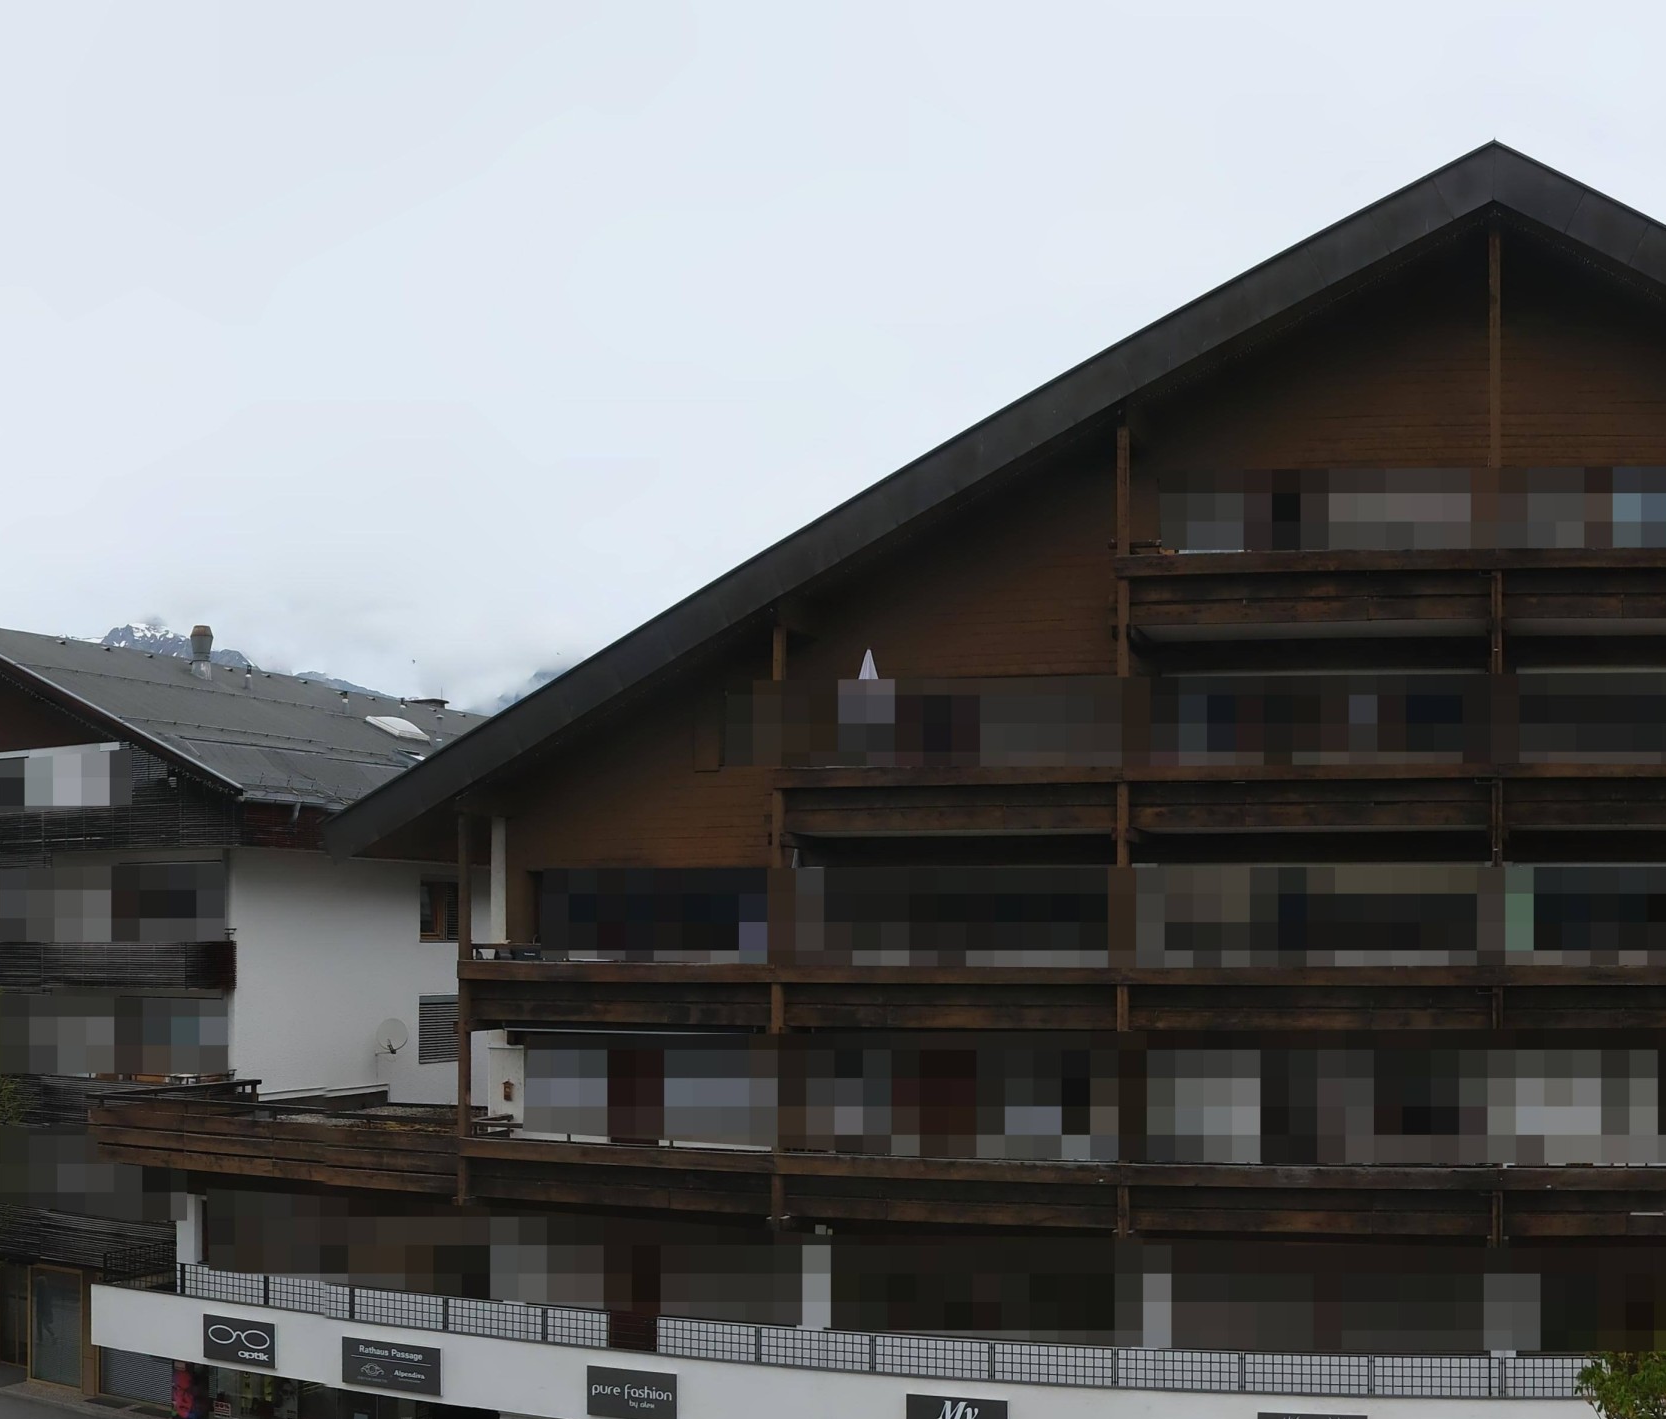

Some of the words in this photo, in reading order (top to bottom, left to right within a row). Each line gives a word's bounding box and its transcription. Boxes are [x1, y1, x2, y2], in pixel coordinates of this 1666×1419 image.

[238, 1350, 269, 1362] optik
[359, 1344, 389, 1356] Rathaus
[391, 1348, 423, 1361] Passage
[592, 1384, 621, 1396] pure
[624, 1383, 672, 1401] fashion
[629, 1400, 639, 1409] by
[640, 1401, 655, 1409] alex
